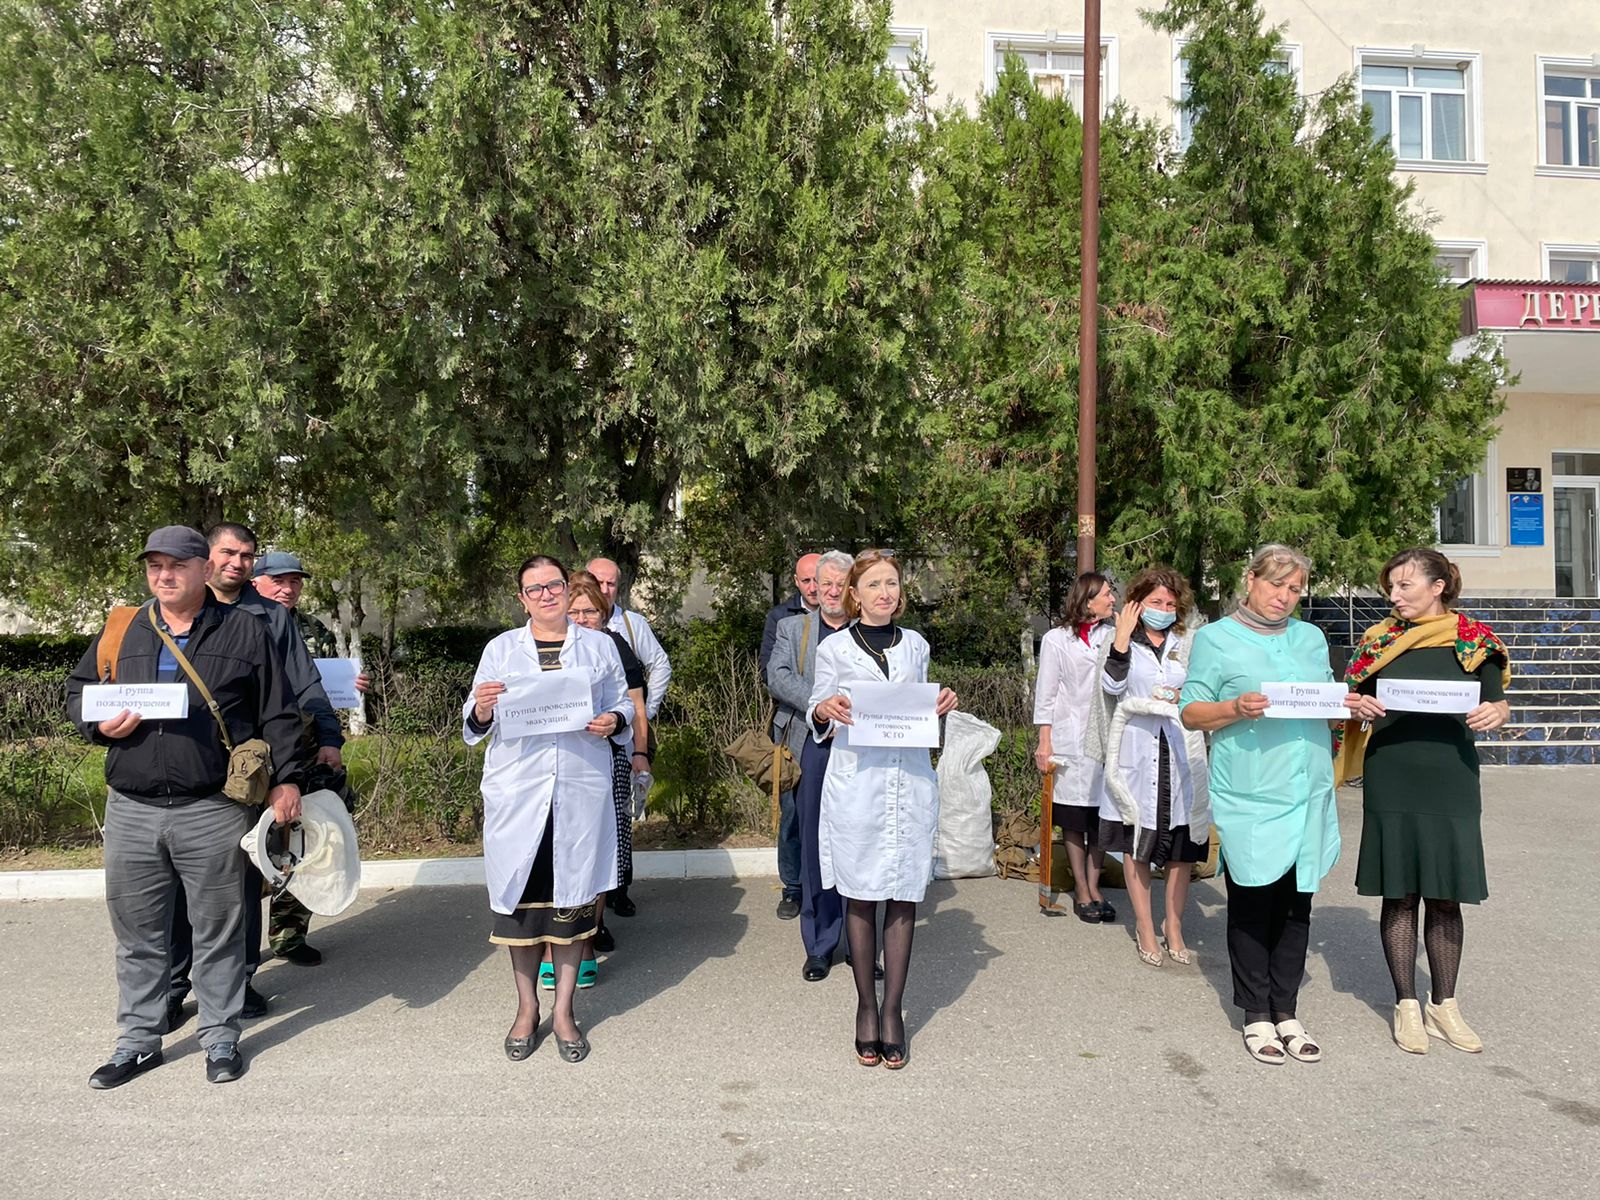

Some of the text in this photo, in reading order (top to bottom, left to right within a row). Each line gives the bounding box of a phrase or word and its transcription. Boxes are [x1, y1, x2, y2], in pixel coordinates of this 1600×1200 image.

[119, 686, 154, 696] Группа
[1290, 686, 1320, 696] Группа
[1386, 687, 1415, 696] Группа
[96, 699, 171, 709] пожаротушения
[504, 700, 588, 718] Группа проведения
[1270, 700, 1317, 708] анитарного
[858, 712, 883, 721] Группа
